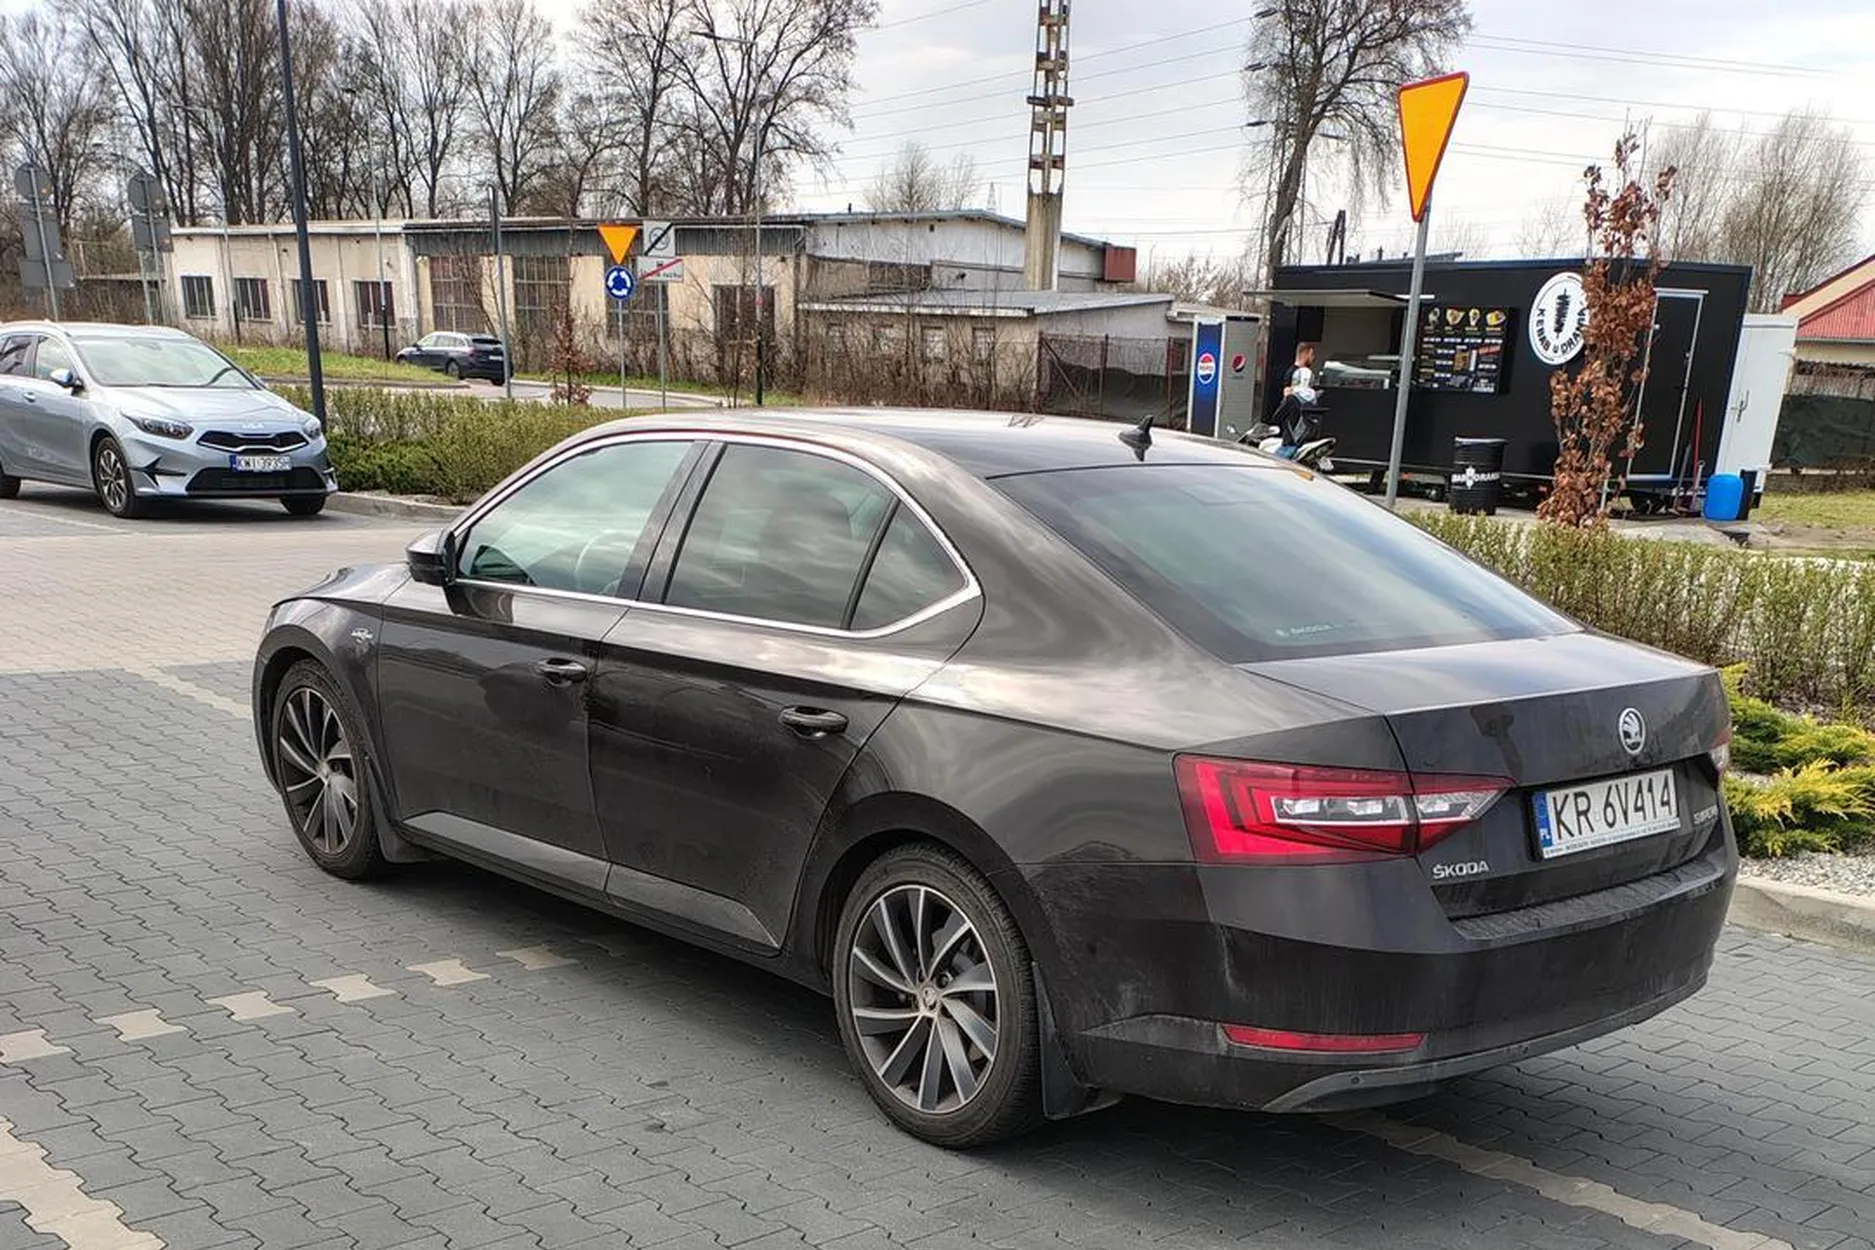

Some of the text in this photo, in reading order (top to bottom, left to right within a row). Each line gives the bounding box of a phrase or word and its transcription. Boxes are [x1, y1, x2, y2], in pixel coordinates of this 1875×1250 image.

[1536, 308, 1551, 352] KEBAB
[1553, 791, 1595, 840] KR
[1603, 774, 1673, 829] 6V414
[1433, 860, 1490, 880] ŠKODA
